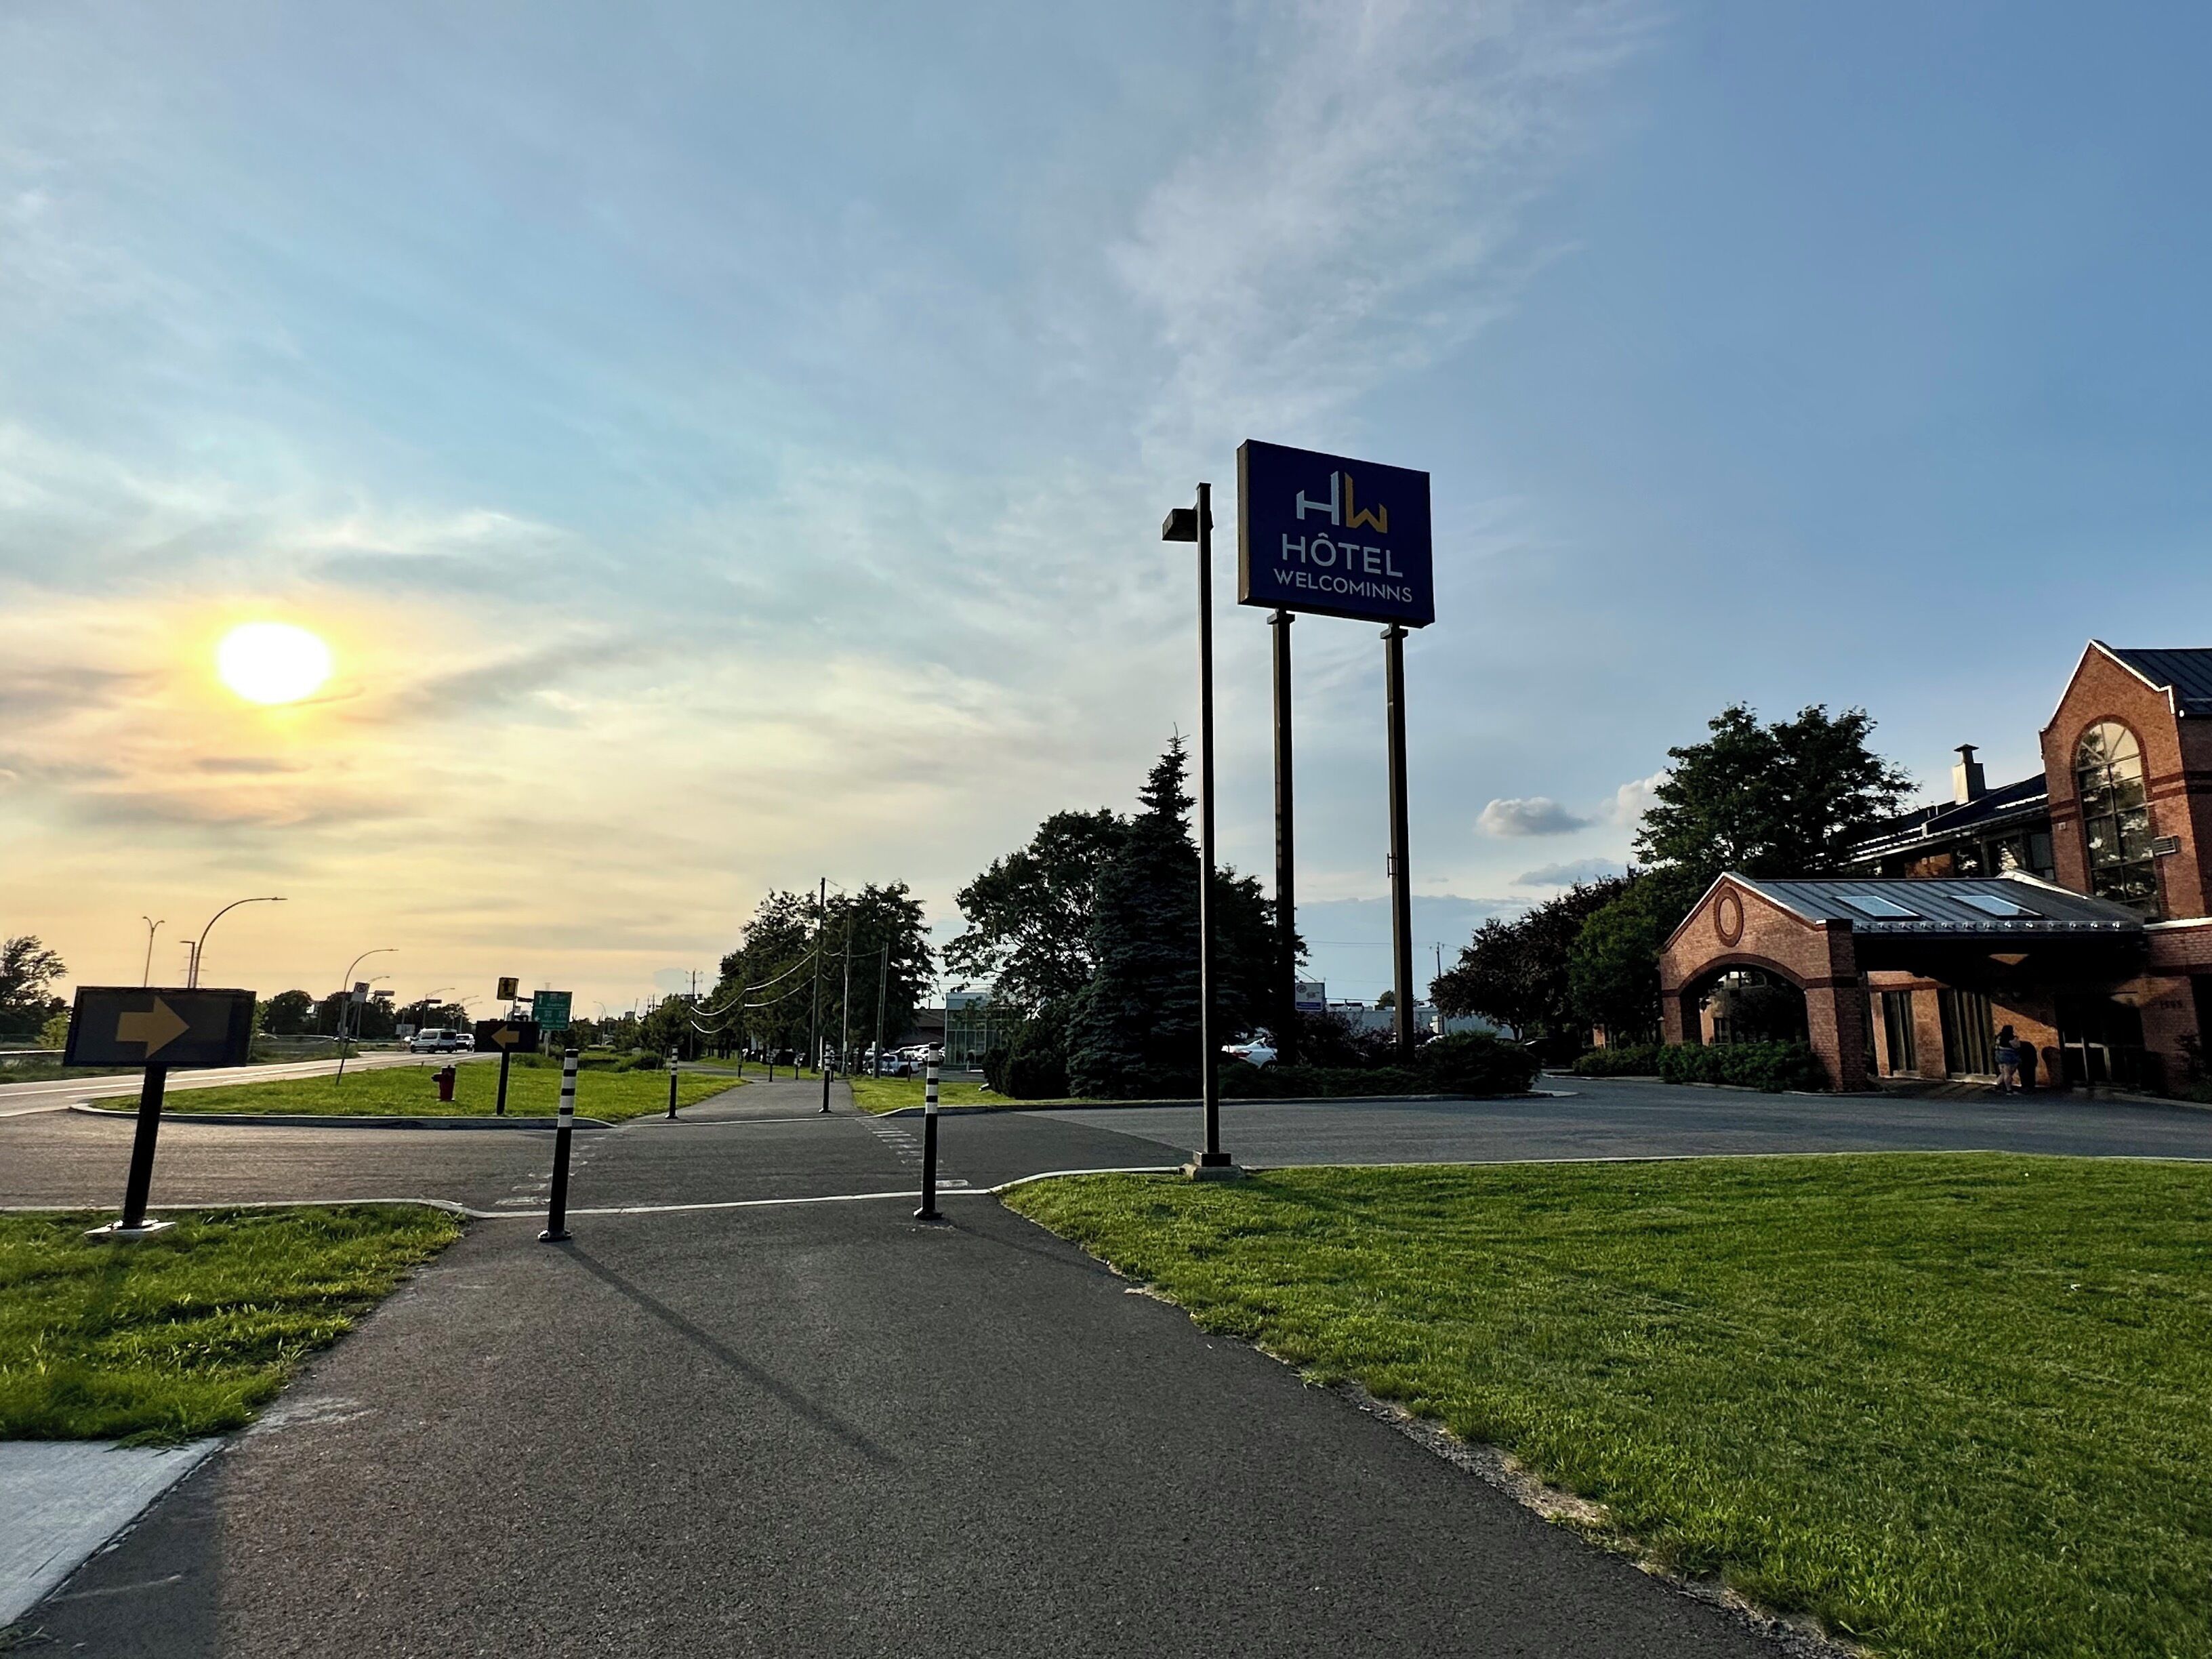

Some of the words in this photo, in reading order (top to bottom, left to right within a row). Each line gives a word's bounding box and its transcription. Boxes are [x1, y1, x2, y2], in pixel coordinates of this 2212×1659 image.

[1296, 471, 1387, 533] HW
[1282, 532, 1403, 577] HÔTEL
[1273, 568, 1412, 602] WELCOMINNS
